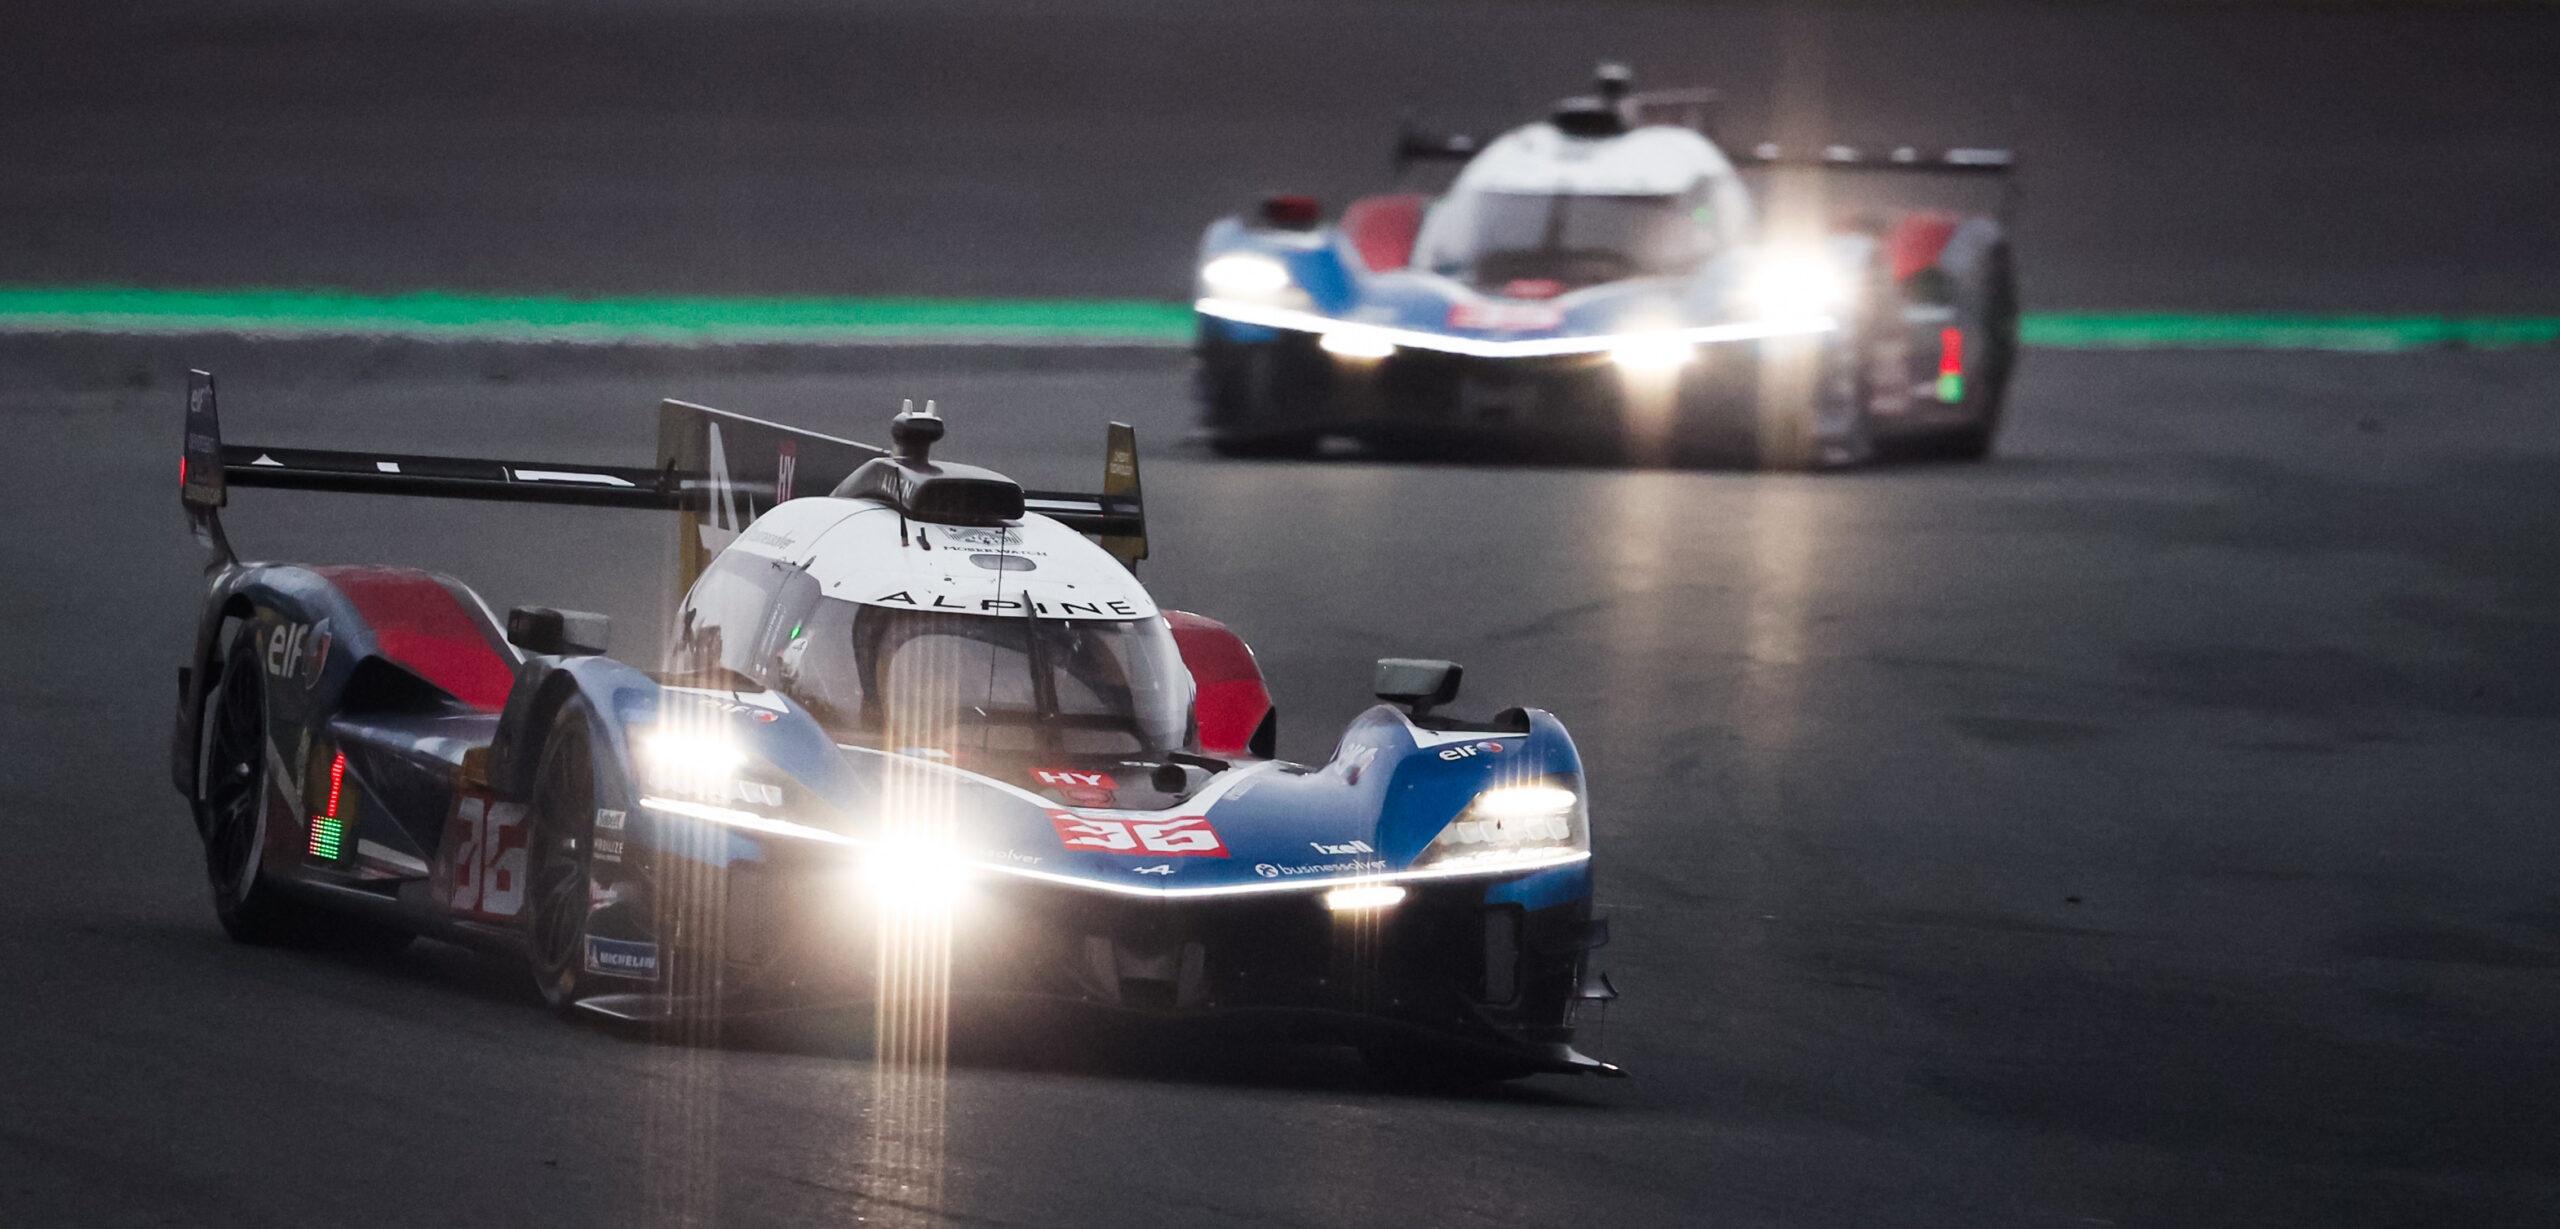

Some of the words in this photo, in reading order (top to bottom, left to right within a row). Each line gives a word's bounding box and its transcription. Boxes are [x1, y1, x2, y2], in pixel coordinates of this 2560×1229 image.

[876, 591, 1138, 615] ALPINE
[267, 622, 309, 679] elf
[1438, 745, 1477, 761] elf
[1038, 771, 1103, 786] HY
[1054, 814, 1220, 852] 36
[451, 797, 529, 916] 36
[1277, 859, 1386, 875] businessolver
[600, 951, 656, 969] MICHELIN
